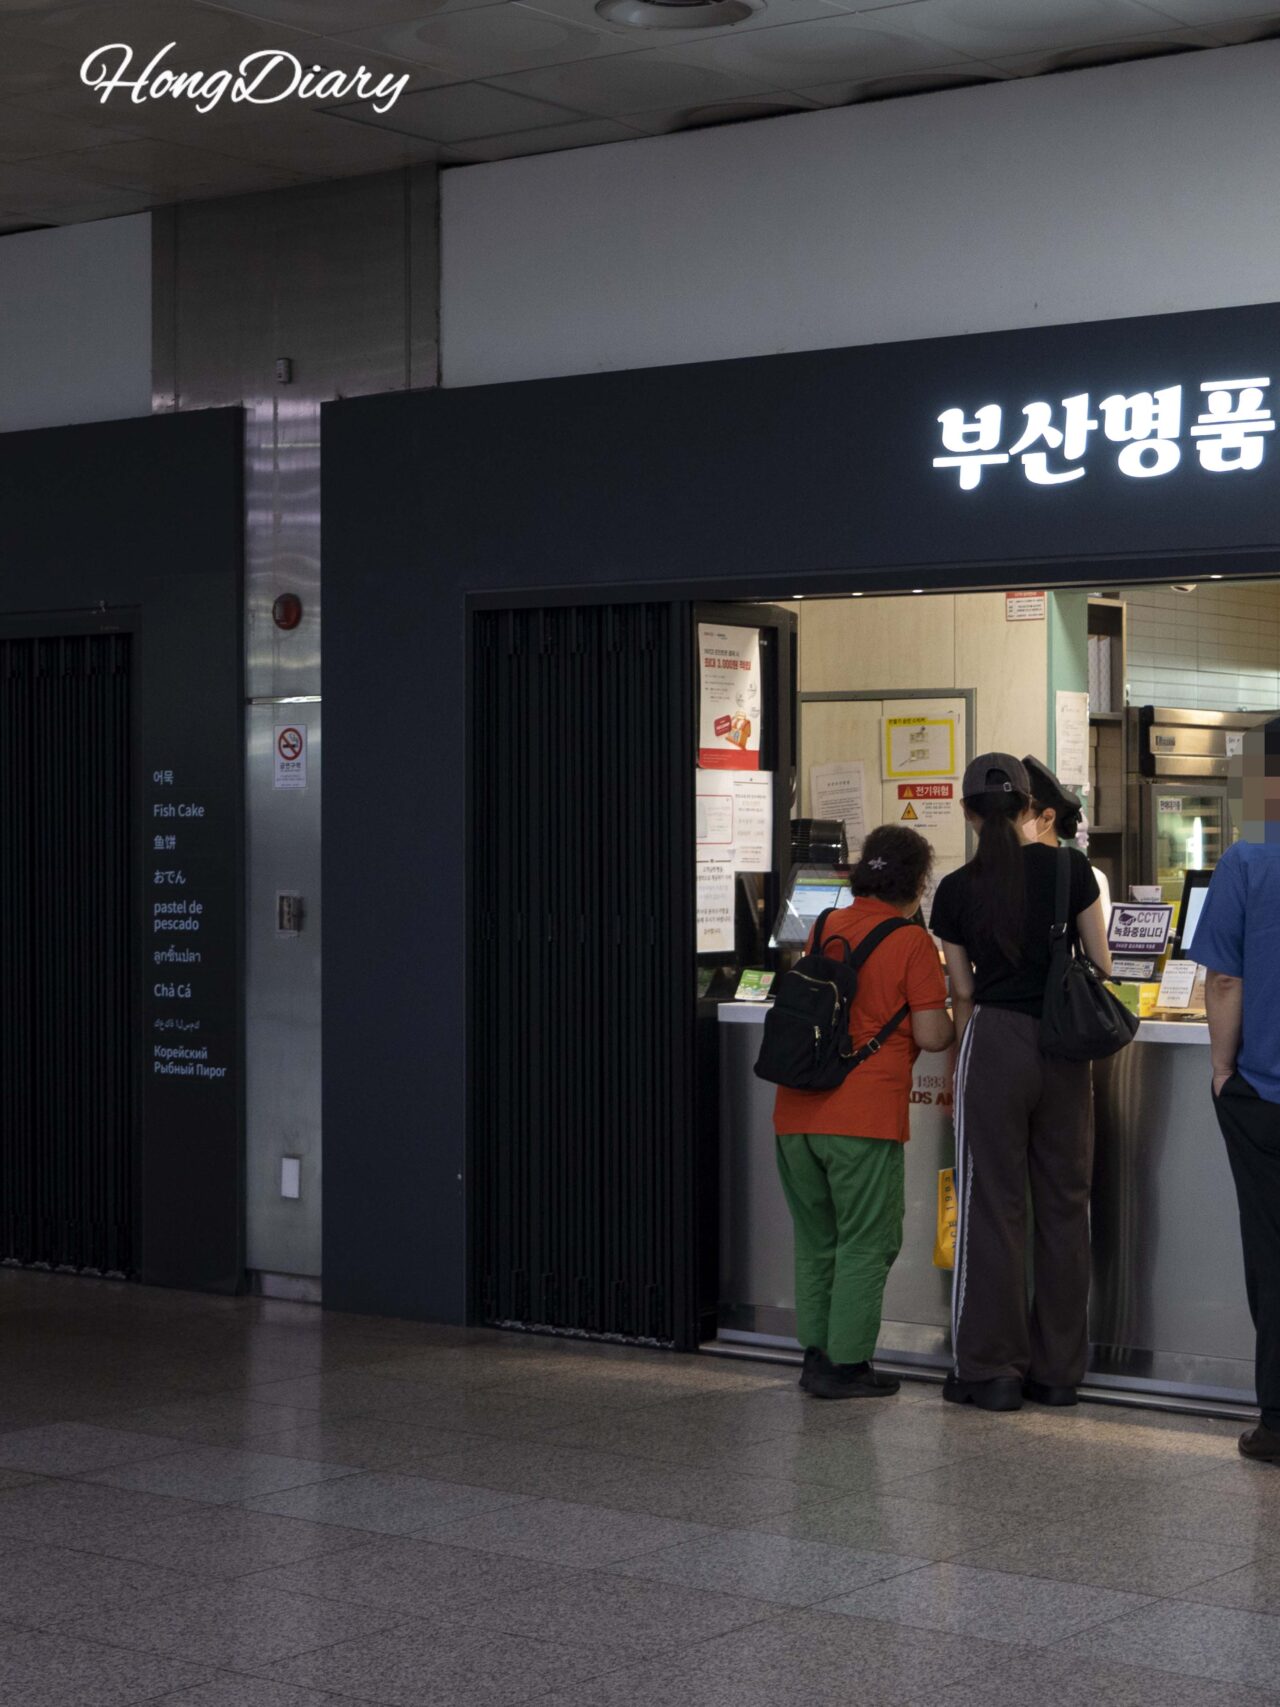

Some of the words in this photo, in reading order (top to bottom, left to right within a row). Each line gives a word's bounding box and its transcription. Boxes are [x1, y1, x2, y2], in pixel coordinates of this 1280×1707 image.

[153, 770, 175, 785] 어묵
[915, 786, 950, 797] 전기위험
[153, 803, 176, 817] Fish
[177, 803, 206, 817] Cake
[153, 835, 177, 850] 鱼饼
[153, 869, 187, 885] おでん
[154, 900, 187, 916] pastel
[188, 900, 204, 914] de
[154, 917, 200, 932] pescado
[1137, 912, 1166, 924] CCTV
[1114, 926, 1163, 938] 녹화중입니다
[177, 983, 192, 998] Cá
[154, 1045, 208, 1060] Корейский
[154, 1061, 194, 1076] Рыбный
[196, 1063, 227, 1080] Пирог
